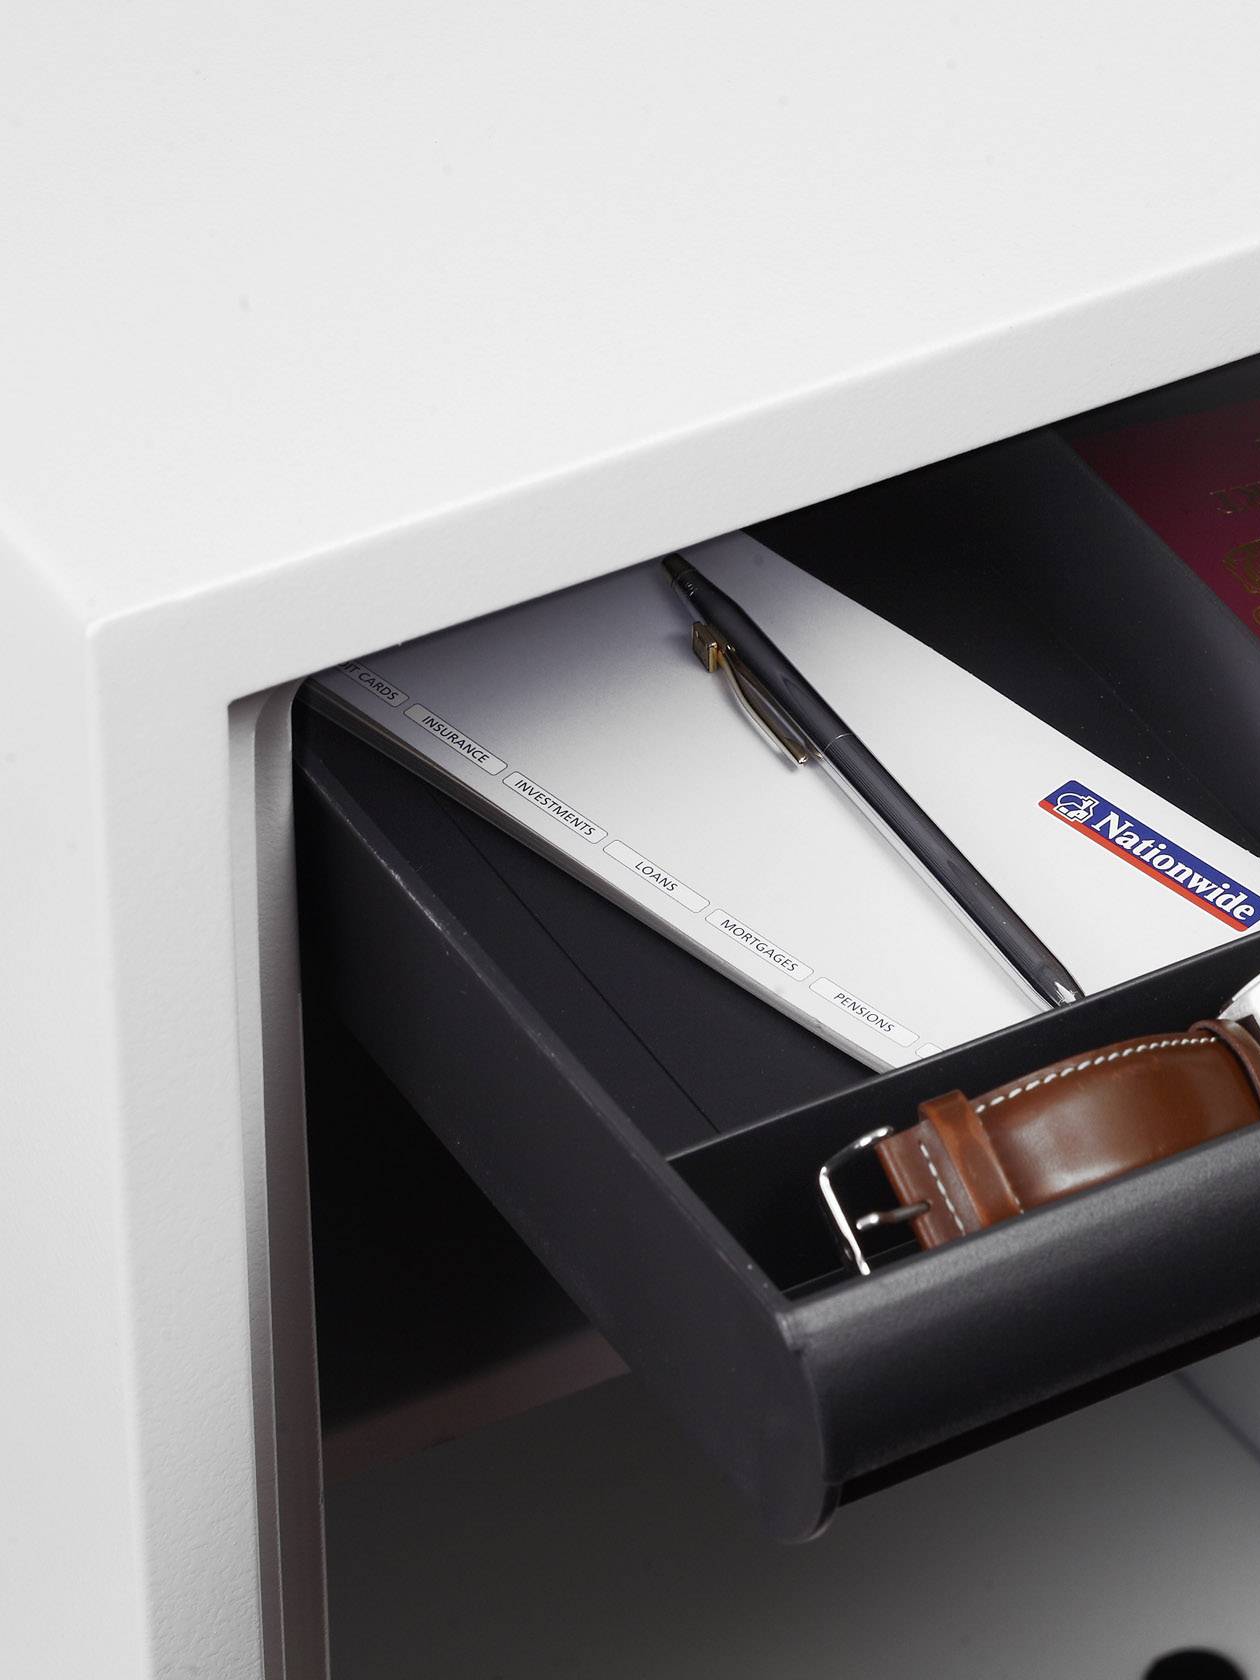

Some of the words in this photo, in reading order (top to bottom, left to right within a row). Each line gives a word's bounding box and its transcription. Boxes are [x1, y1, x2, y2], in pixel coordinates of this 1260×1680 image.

[358, 672, 399, 700] CARDS
[421, 714, 490, 765] INSURANCE
[514, 778, 597, 837] INVESTMENTS
[634, 861, 679, 893] LOANS
[1092, 811, 1255, 921] Nationwide
[720, 918, 799, 974] MORTGAGES
[832, 991, 896, 1035] PENSIONS
